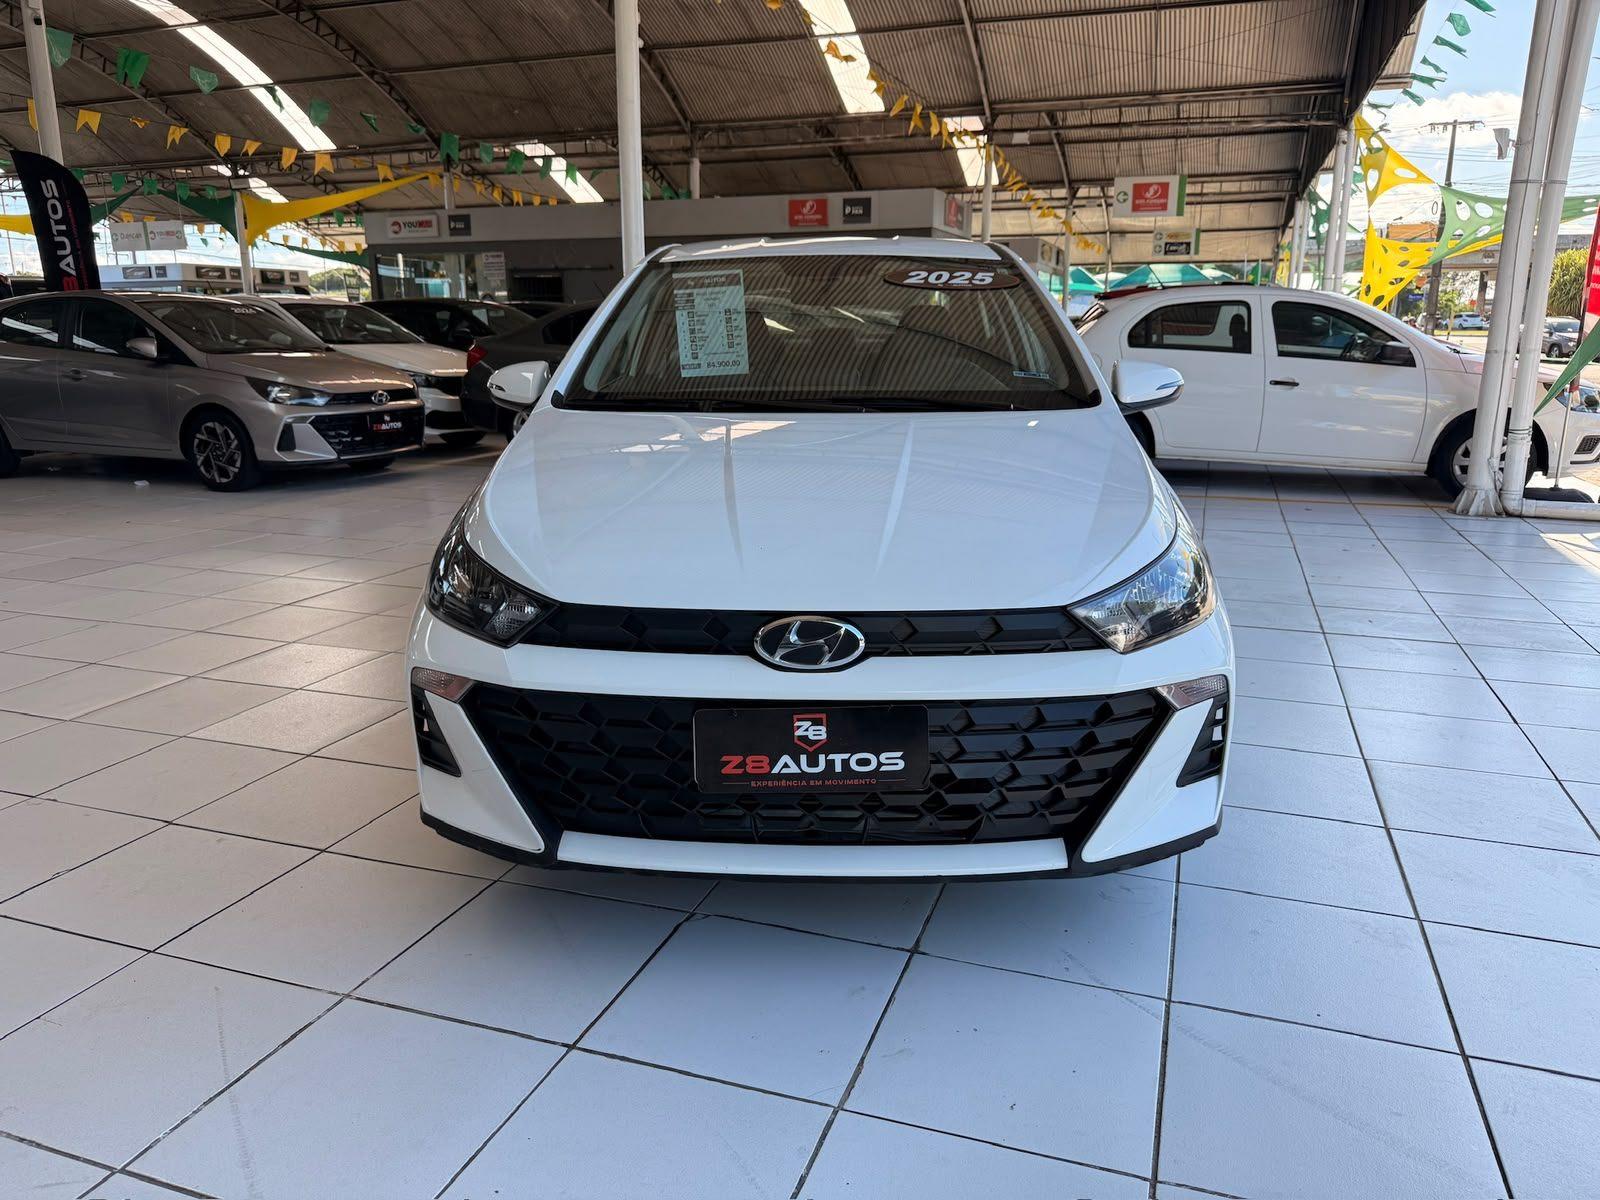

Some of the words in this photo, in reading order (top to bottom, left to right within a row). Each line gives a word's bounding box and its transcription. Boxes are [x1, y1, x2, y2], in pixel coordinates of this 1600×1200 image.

[903, 271, 994, 284] 2025
[706, 360, 741, 369] 84.900,00
[794, 721, 826, 741] Z8
[720, 751, 906, 774] Z8AUTOS
[750, 779, 808, 787] EXPERIÊNCIA
[825, 778, 877, 786] MOVIMENTO
